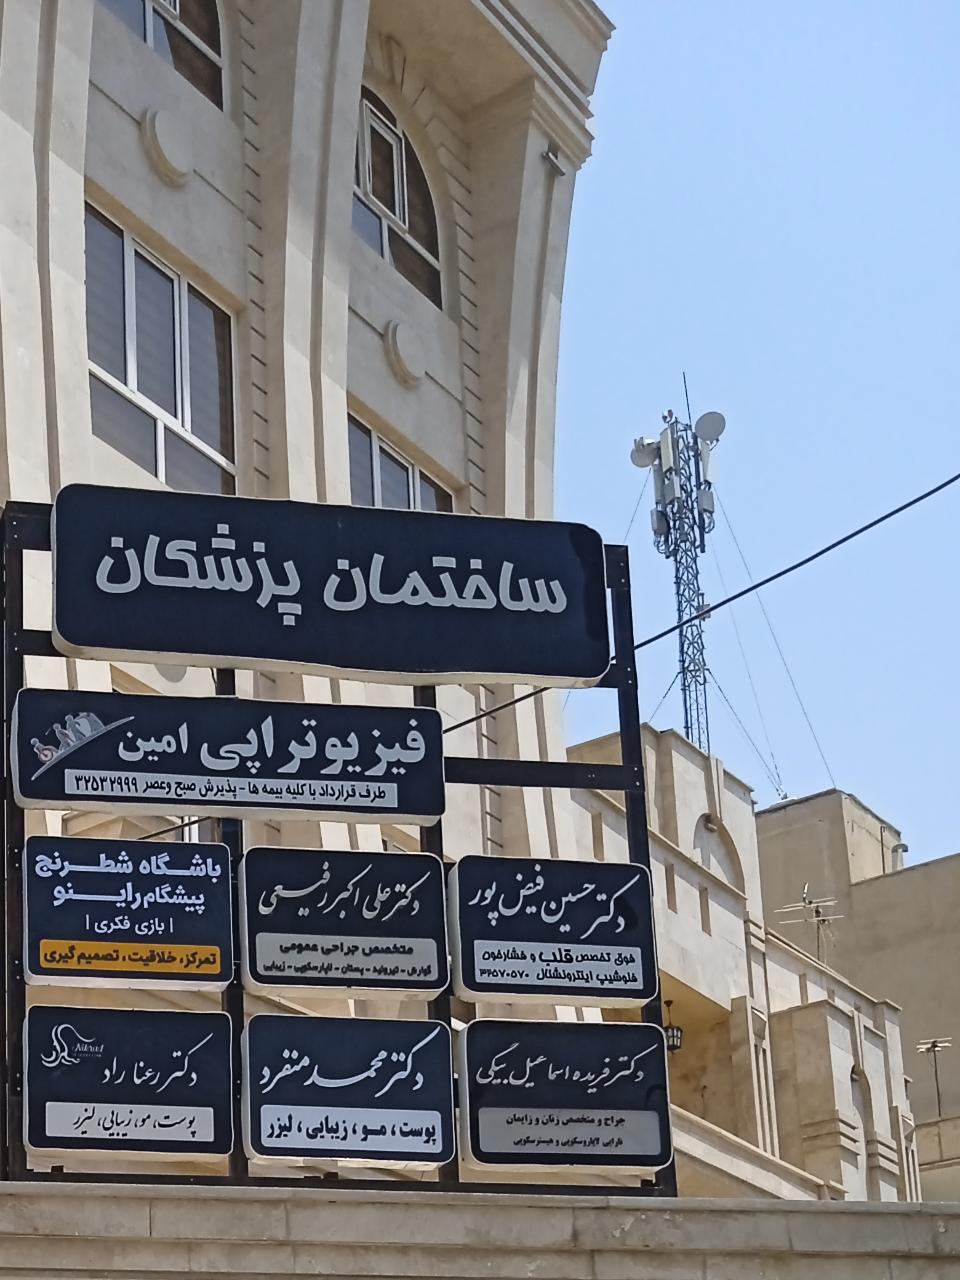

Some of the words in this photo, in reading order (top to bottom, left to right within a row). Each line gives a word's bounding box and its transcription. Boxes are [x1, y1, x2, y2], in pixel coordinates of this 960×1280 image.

[94, 523, 302, 626] پزشکان
[323, 553, 568, 614] ساختمان
[118, 722, 189, 762] امین
[75, 775, 138, 793] ۳۲۵۳۲۹۹۹
[174, 781, 196, 797] صبح
[198, 778, 237, 799] پذیرش
[248, 782, 259, 795] ها
[261, 784, 283, 799] بیمه
[285, 782, 306, 799] کلیه
[308, 783, 316, 800] با
[318, 783, 356, 802] قرارداد
[358, 786, 386, 803] طرف
[34, 850, 133, 877] شطرنج
[139, 852, 222, 883] باشگاه
[52, 881, 141, 909] راینو
[143, 883, 205, 914] پیشگام
[258, 861, 331, 917] رفیعی
[322, 863, 373, 919] اکبر
[381, 871, 431, 922] دکتر
[498, 864, 545, 916] فیض
[362, 882, 392, 920] علی
[467, 881, 499, 926] پور
[540, 882, 596, 932] حسین
[580, 874, 640, 940] دکتر
[94, 915, 131, 933] فکری
[134, 917, 165, 935] بازی
[43, 945, 76, 963] گیری
[77, 949, 120, 965] تصمیم
[279, 942, 319, 954] عمومی
[320, 942, 360, 956] جراحی
[361, 943, 414, 956] متخصص
[529, 953, 536, 963] و
[538, 948, 574, 966] قلب
[575, 952, 611, 963] تخصص
[614, 953, 636, 966] فوق
[596, 970, 638, 985] فلوشیپ
[102, 1056, 125, 1084] راد
[156, 1032, 214, 1093] دکتر
[259, 1048, 311, 1094] منفرد
[303, 1050, 388, 1088] محمد
[374, 1026, 441, 1098] دکتر
[604, 1043, 658, 1087] دکتر
[133, 1061, 161, 1085] رعنا
[572, 1057, 611, 1094] فریده
[73, 1105, 96, 1135] لیزر
[266, 1113, 293, 1139] لیزر
[506, 1113, 533, 1126] زایمان
[534, 1117, 540, 1126] و
[541, 1114, 560, 1126] زنان
[561, 1115, 595, 1126] متخصص
[596, 1118, 602, 1126] و
[603, 1115, 626, 1127] جراح
